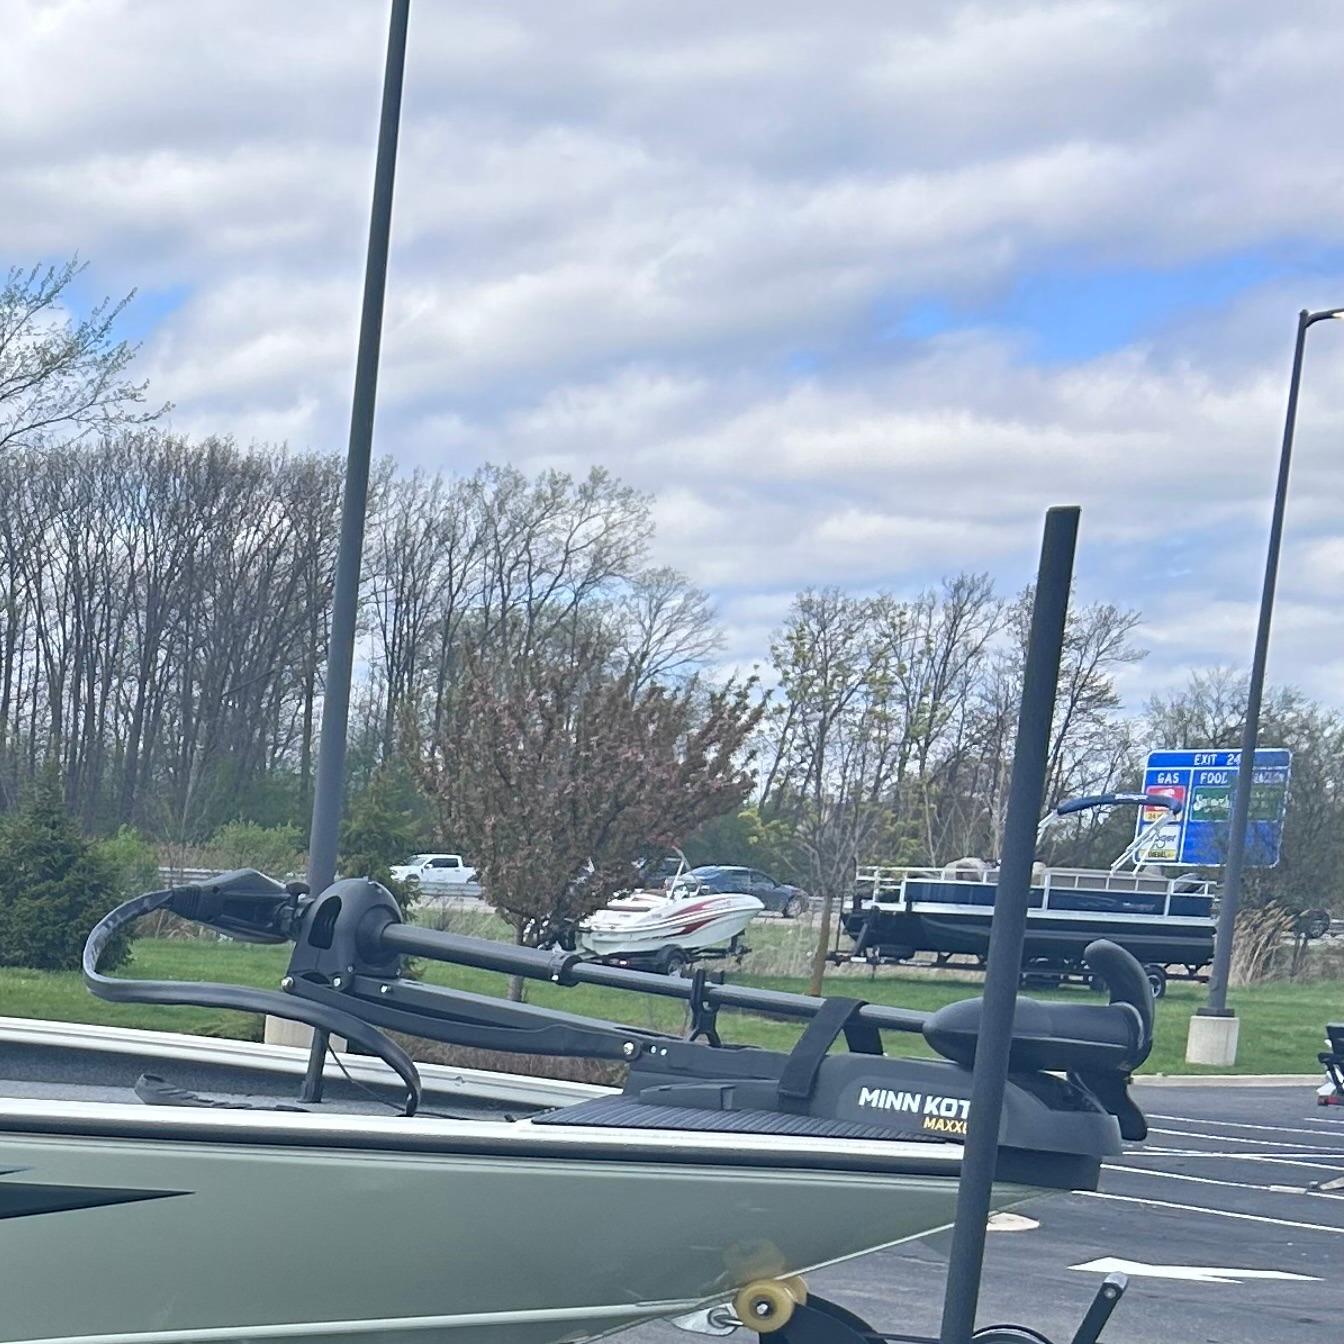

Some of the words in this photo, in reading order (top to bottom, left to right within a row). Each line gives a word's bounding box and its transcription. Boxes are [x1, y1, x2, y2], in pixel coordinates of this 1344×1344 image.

[1193, 753, 1218, 766] EXIT
[1157, 772, 1180, 784] GAS
[858, 1087, 922, 1113] MINN
[923, 1095, 971, 1119] KOT
